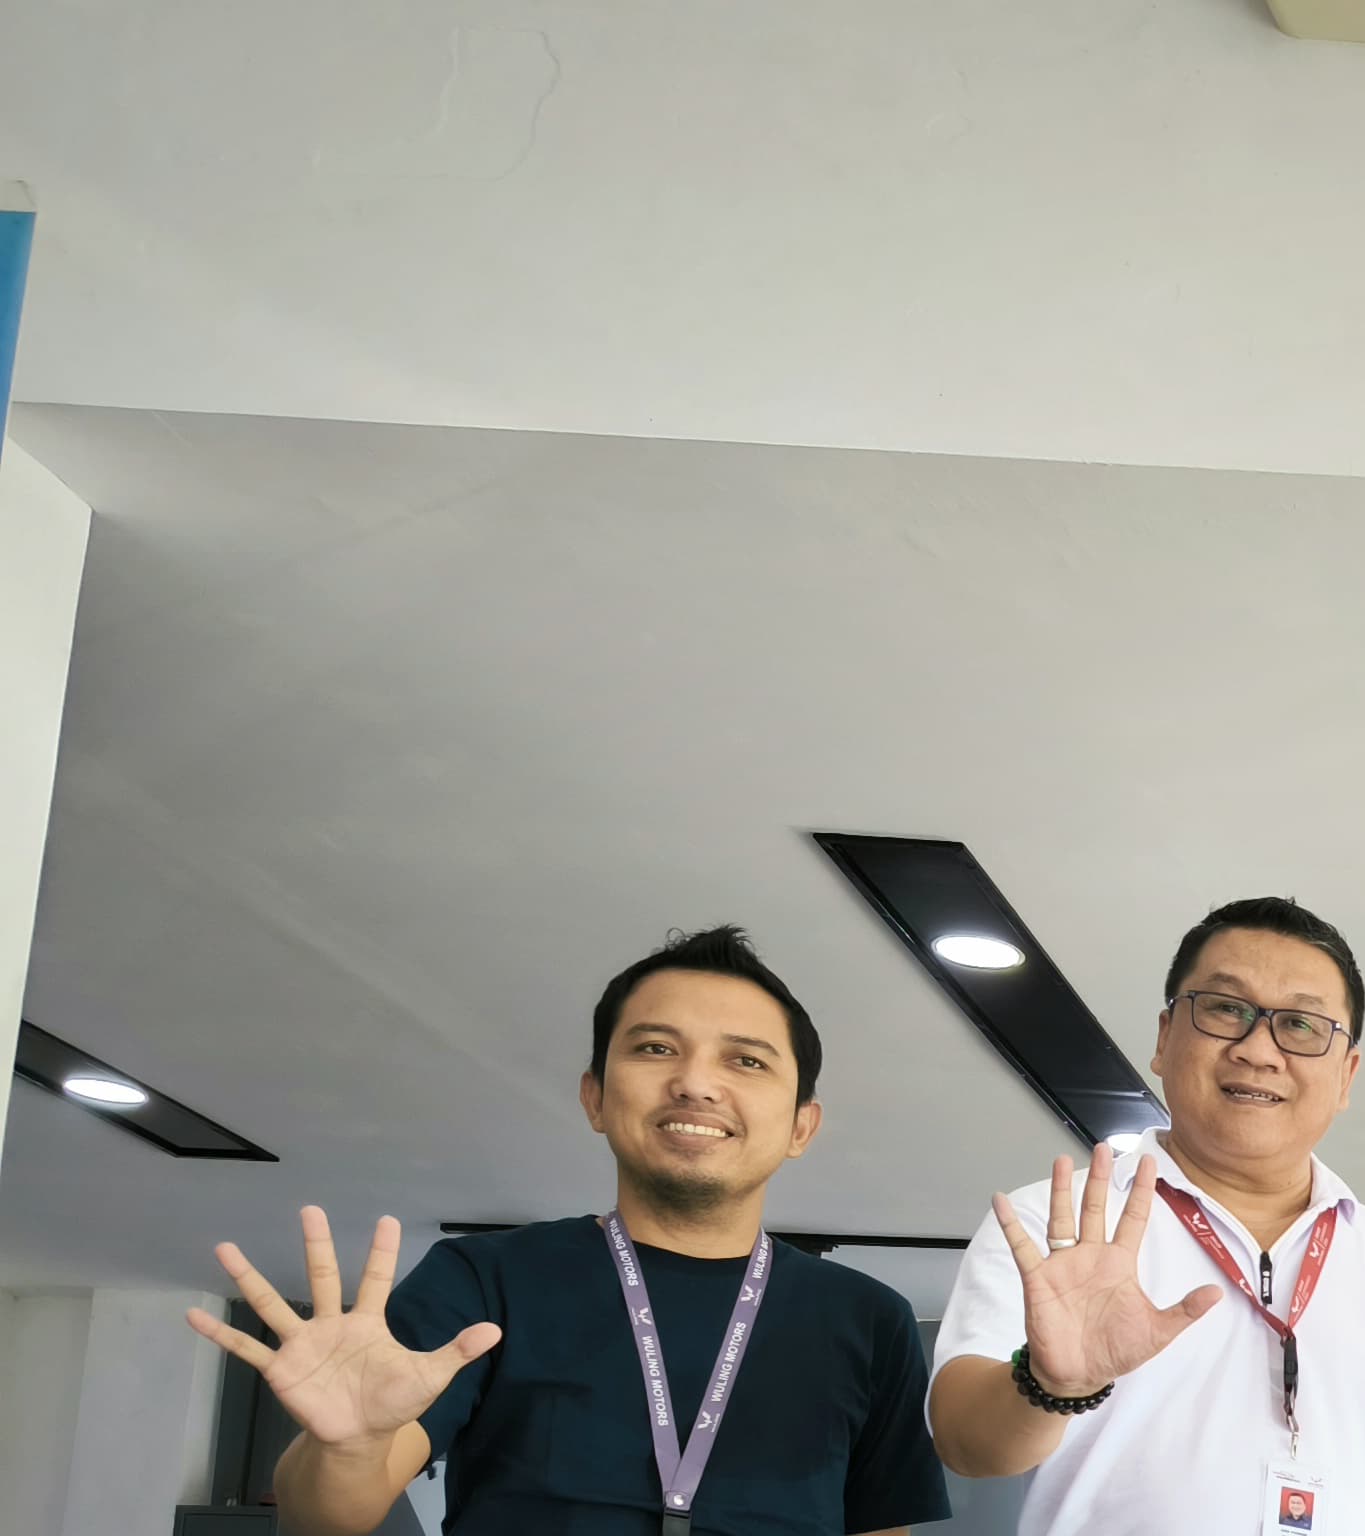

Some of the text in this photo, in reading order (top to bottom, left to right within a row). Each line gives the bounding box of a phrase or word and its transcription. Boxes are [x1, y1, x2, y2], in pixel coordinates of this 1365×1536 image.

[608, 1218, 639, 1287] WULING MOTORS
[642, 1336, 669, 1427] WULING MOTORS
[711, 1363, 733, 1402] WULING
[724, 1321, 747, 1362] MOTORS
